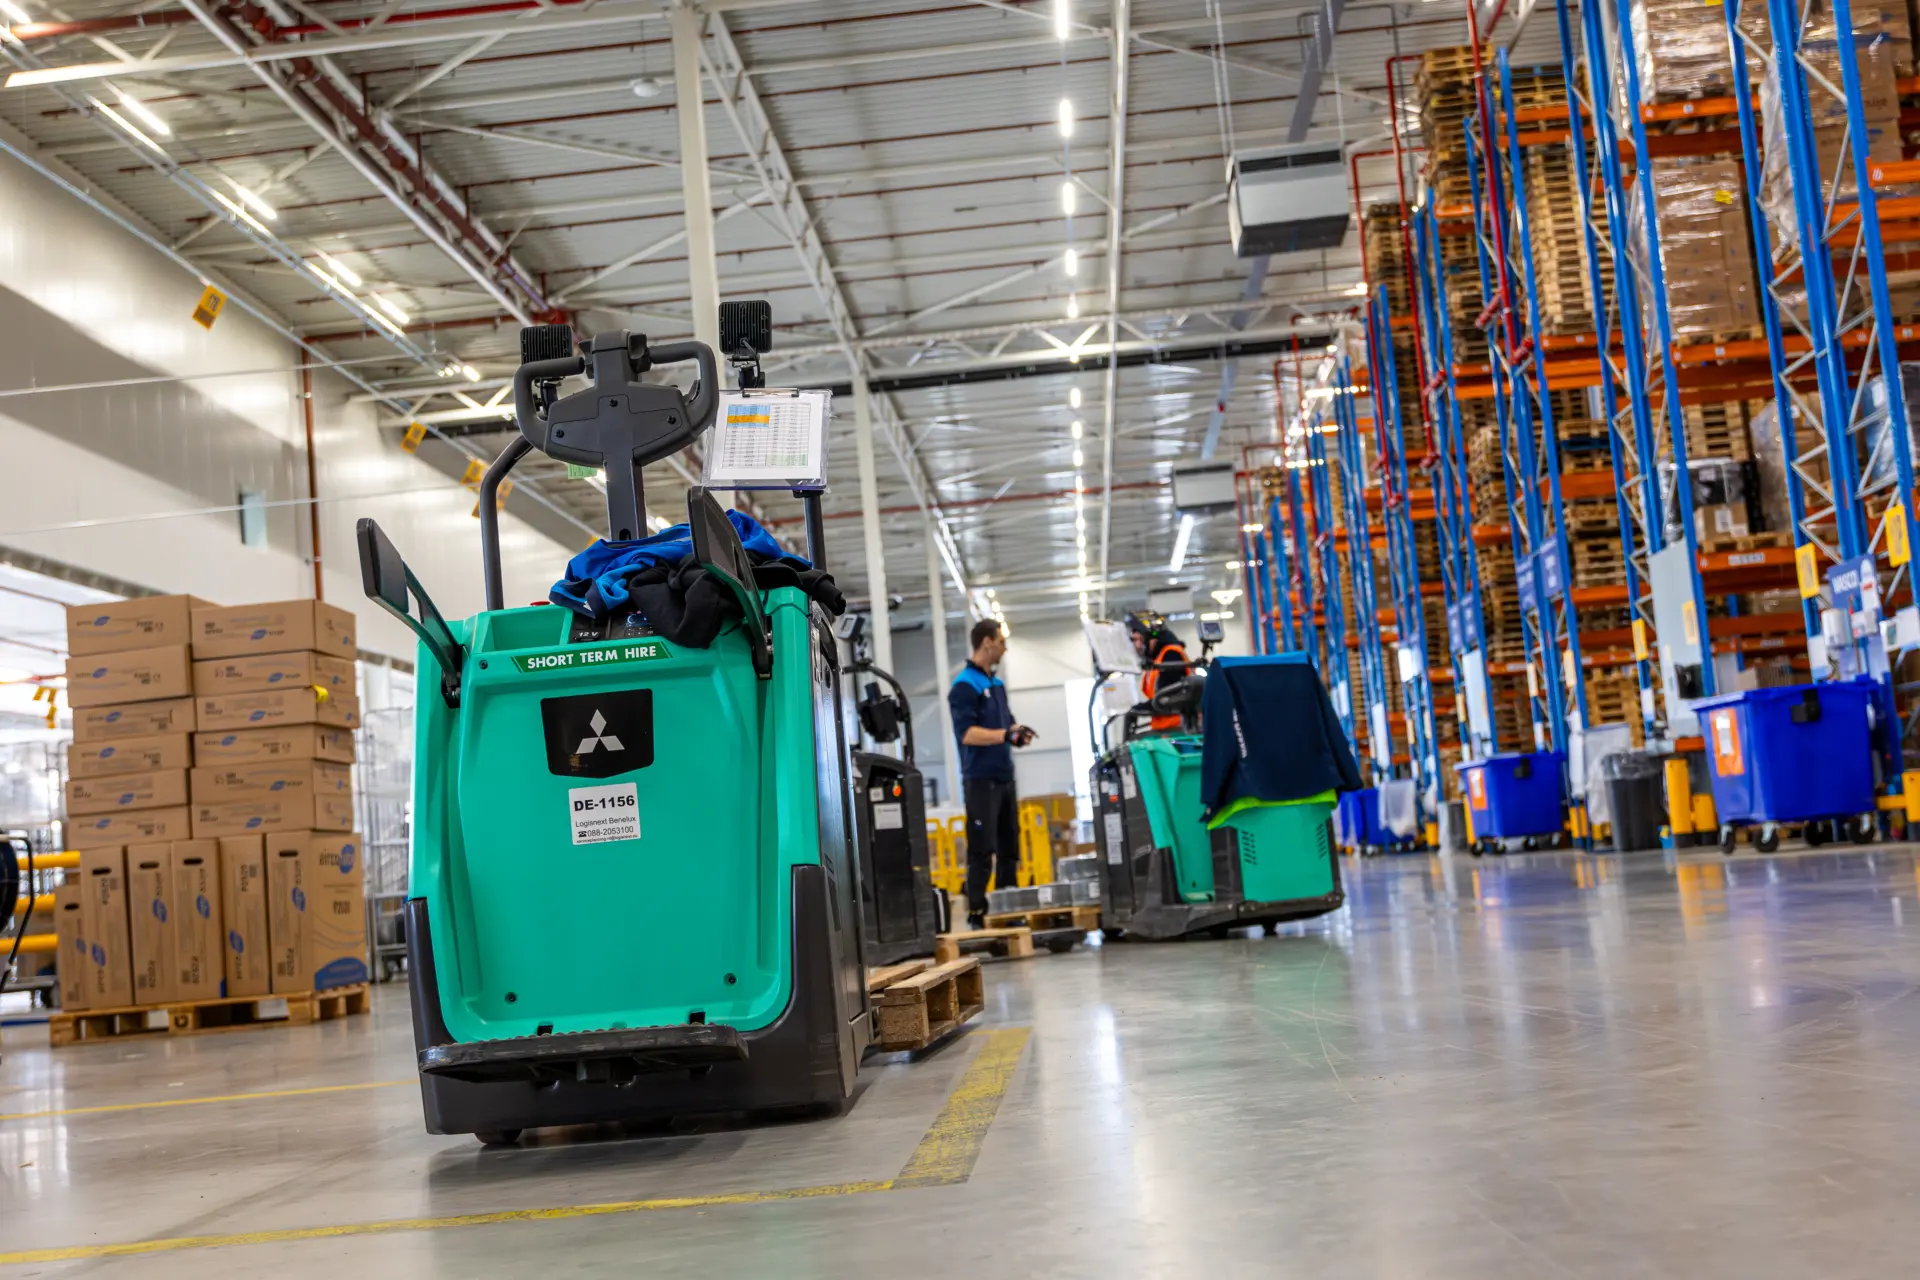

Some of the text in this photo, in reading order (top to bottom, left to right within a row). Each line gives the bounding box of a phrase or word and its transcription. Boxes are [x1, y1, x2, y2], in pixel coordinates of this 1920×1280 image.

[527, 645, 657, 669] SHORT TERM HIRE
[574, 795, 635, 812] DE-1156
[575, 816, 636, 828] Logisnext Benelux
[587, 825, 634, 837] 088-2053100
